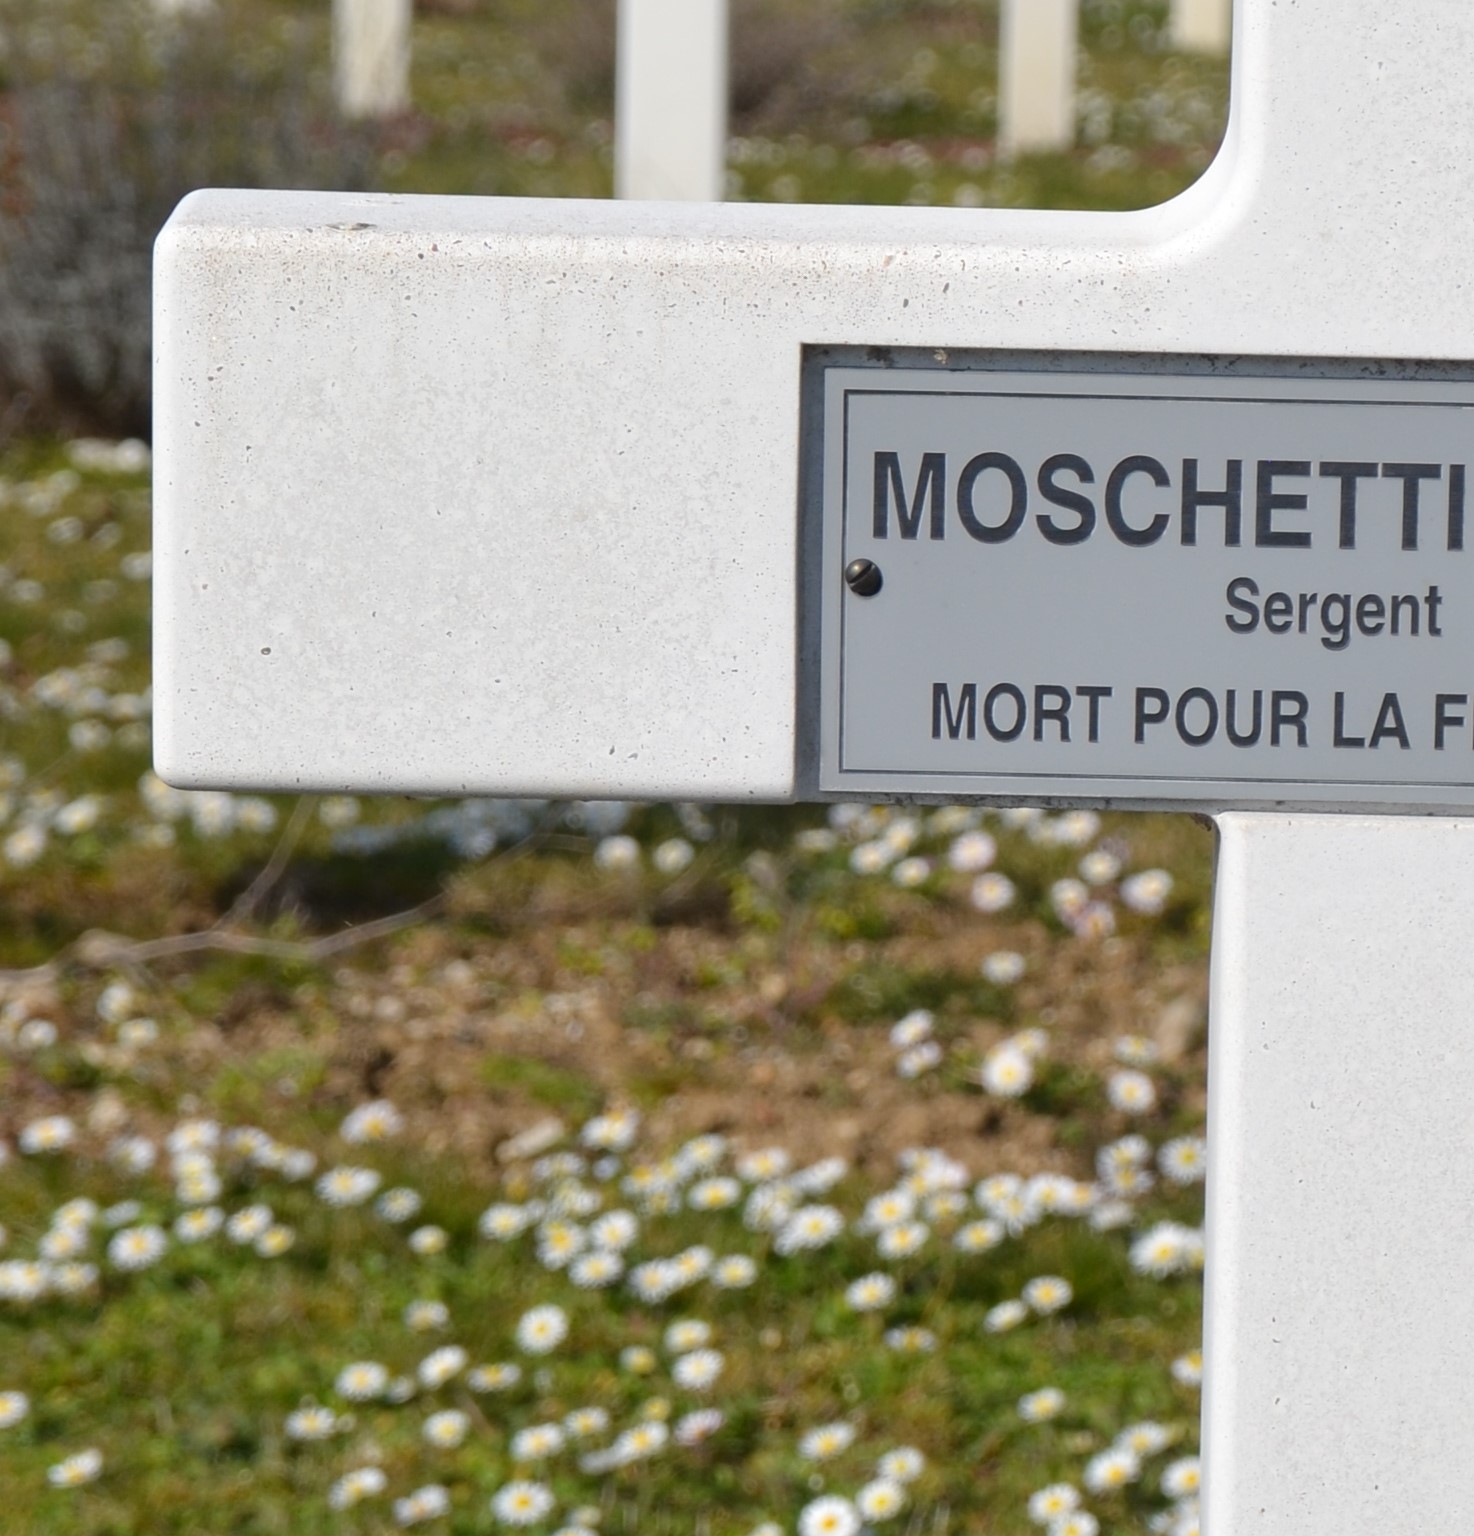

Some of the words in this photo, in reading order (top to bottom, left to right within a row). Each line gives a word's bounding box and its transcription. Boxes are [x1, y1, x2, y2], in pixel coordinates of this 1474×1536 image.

[871, 450, 1467, 552] MOSCHETTI
[1224, 576, 1444, 652] Sergent
[930, 681, 1114, 744] MORT
[1133, 686, 1310, 749] POUR
[1332, 691, 1411, 751] LA
